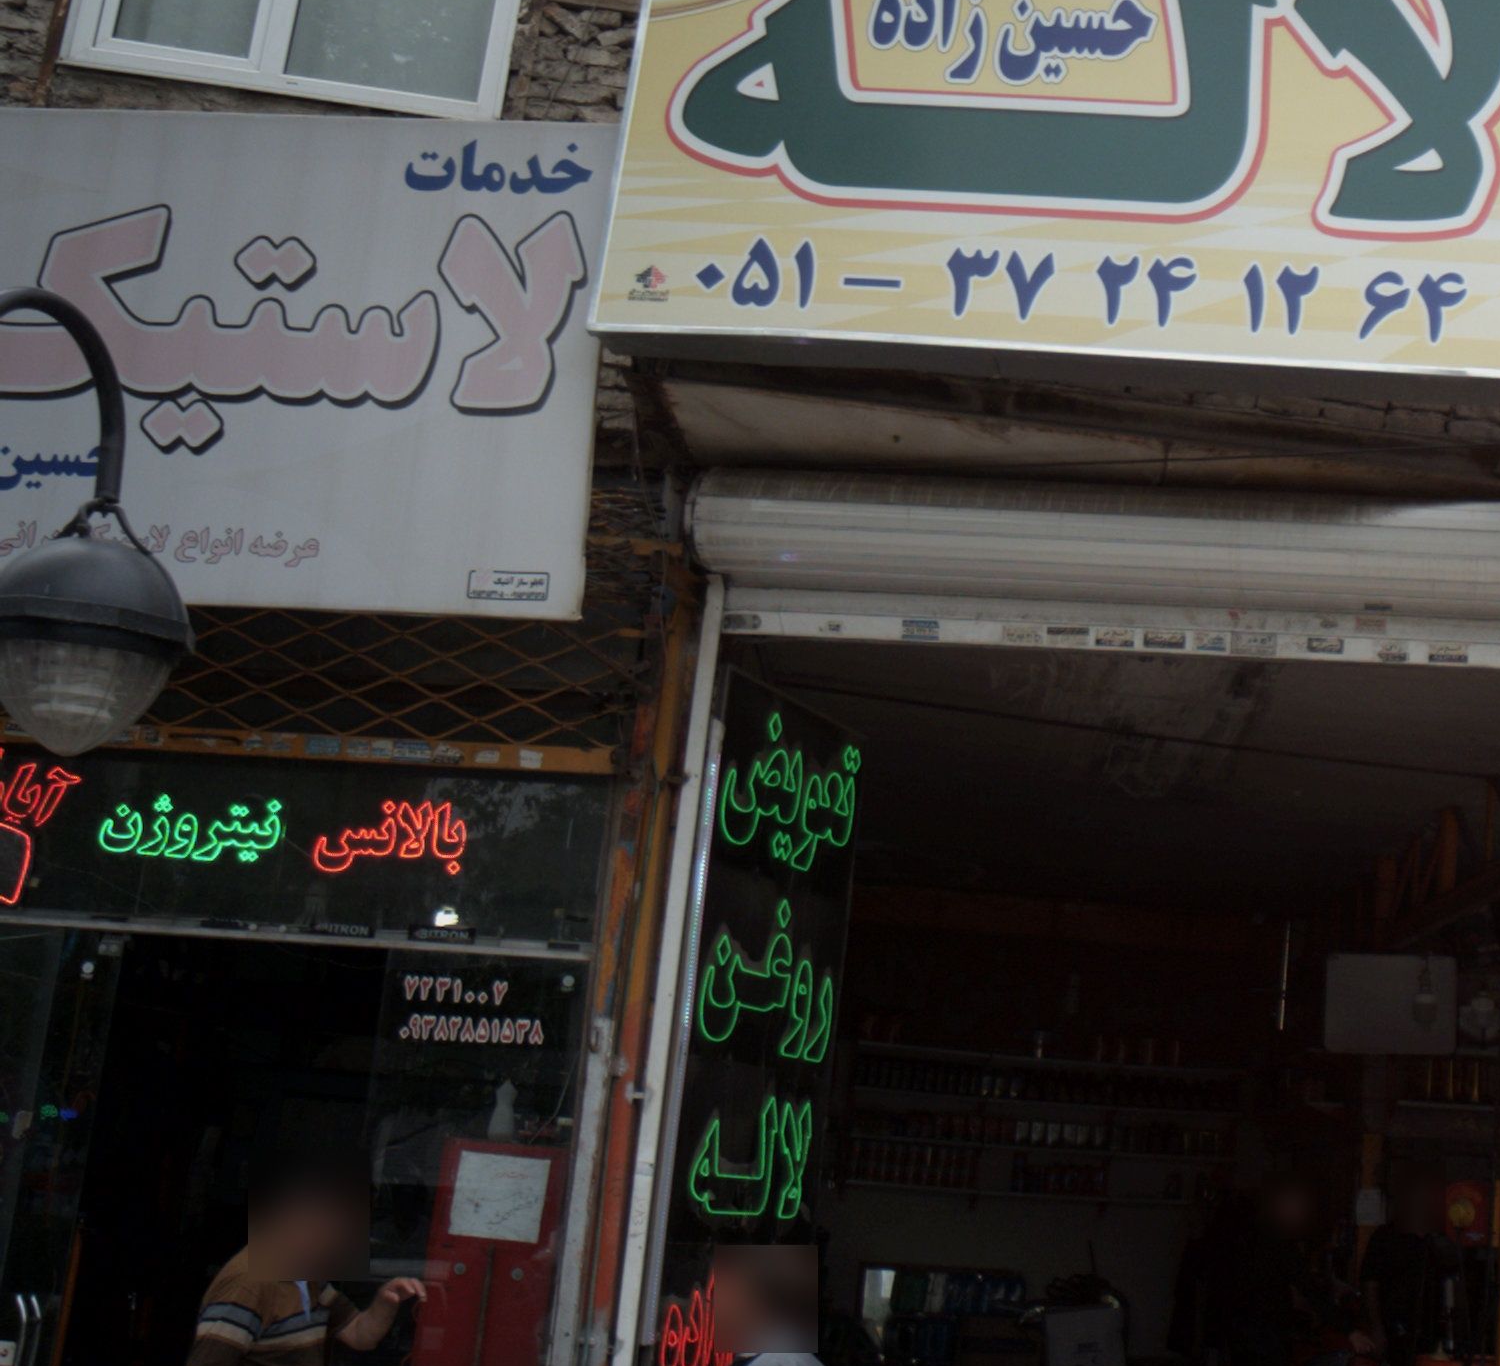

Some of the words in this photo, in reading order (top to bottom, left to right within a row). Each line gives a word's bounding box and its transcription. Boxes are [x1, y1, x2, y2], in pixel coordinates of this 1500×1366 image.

[404, 140, 593, 195] خدمات
[694, 236, 815, 309] ۰۵۱
[946, 246, 1055, 322] ۳۷
[1096, 254, 1198, 327] ۲۴
[1242, 262, 1320, 335] ۱۲
[1358, 269, 1468, 344] ۶۴
[174, 527, 244, 565] انواع
[250, 532, 320, 568] عرضه
[98, 792, 284, 862] نیتروژن
[721, 712, 861, 872] تعویض
[312, 798, 467, 876] بالانس
[700, 899, 835, 1064] روغن
[690, 1095, 813, 1219] لاله
